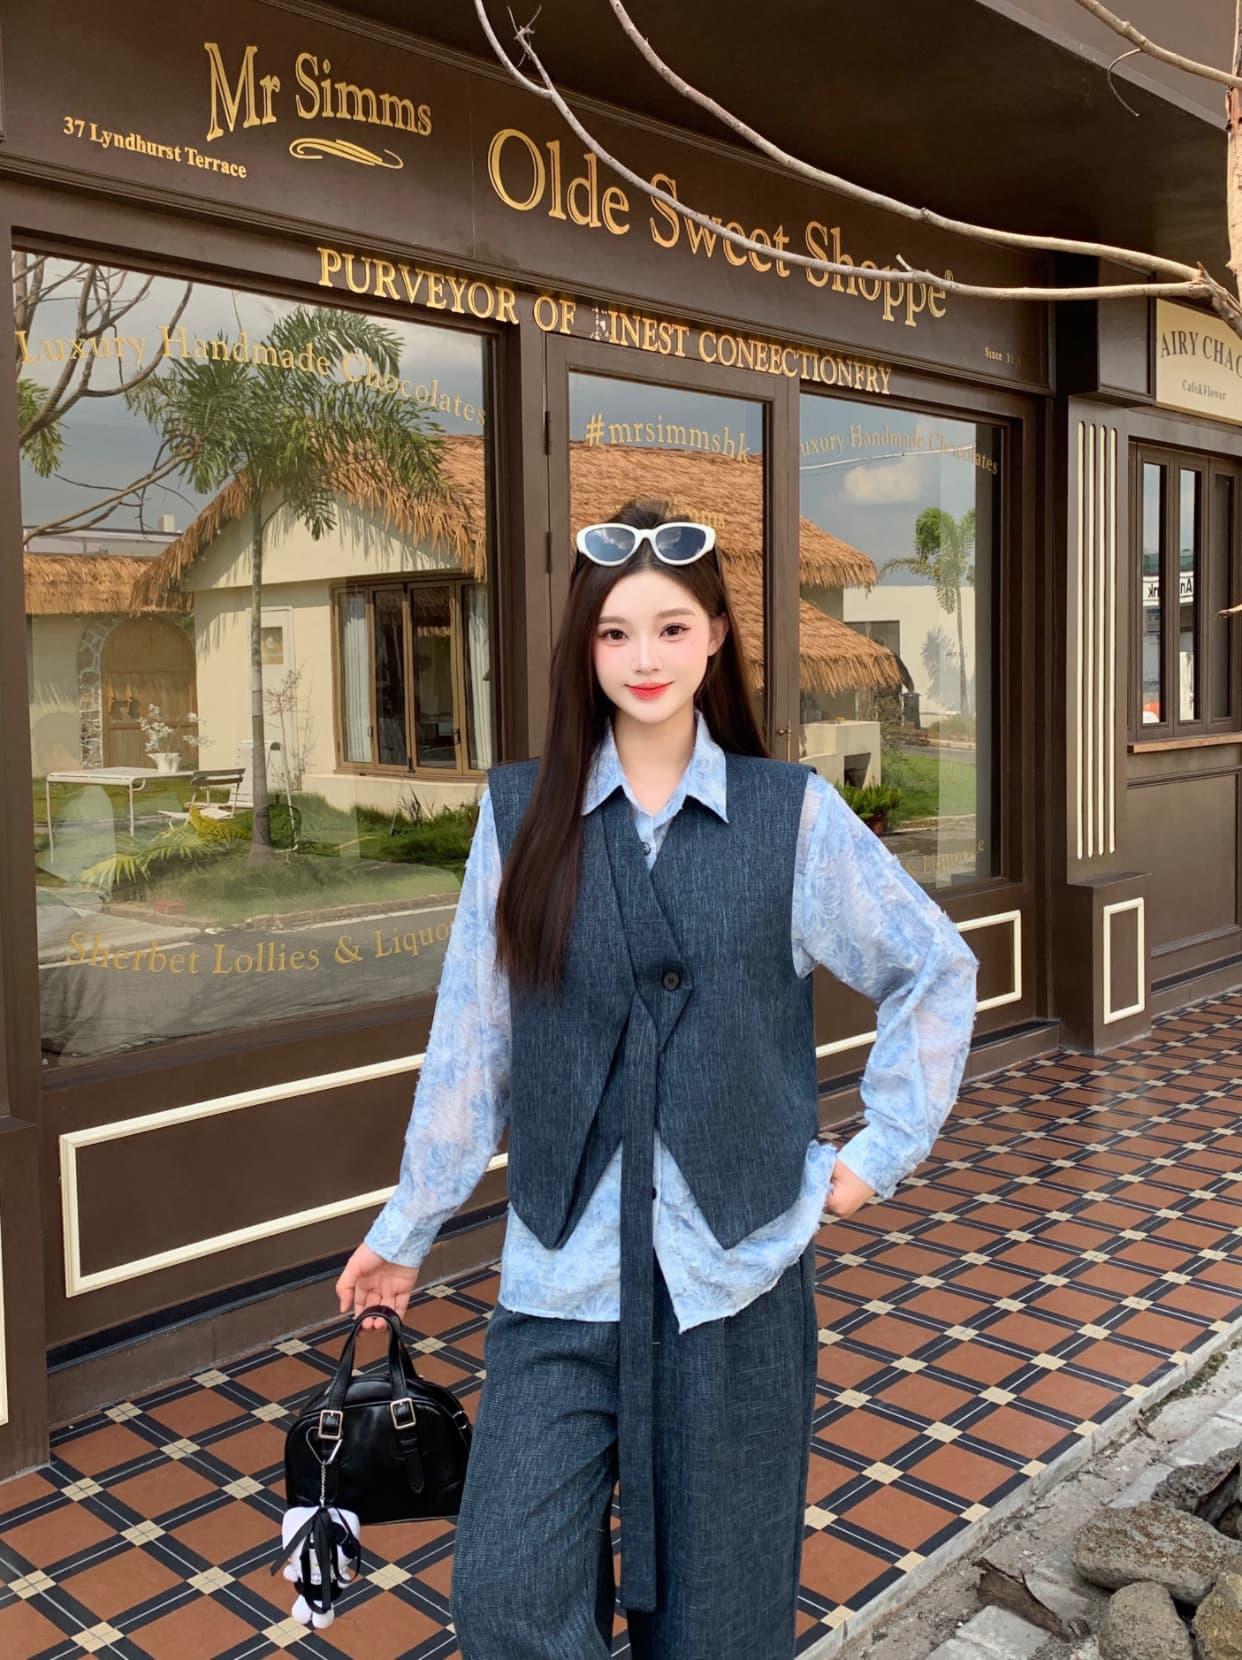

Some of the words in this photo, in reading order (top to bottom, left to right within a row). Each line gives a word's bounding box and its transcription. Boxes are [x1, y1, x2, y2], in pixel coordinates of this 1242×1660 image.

[204, 42, 281, 142] Mr
[295, 52, 433, 137] Simms
[63, 116, 85, 139] 37
[90, 122, 182, 163] Lyndhurst
[184, 148, 248, 179] Terrace
[487, 128, 631, 235] Olde
[650, 173, 791, 278] Sweet
[805, 220, 947, 327] Shoppe
[316, 247, 520, 325] PURVEYOR
[533, 295, 576, 334] OF
[15, 330, 146, 366] Luxury
[158, 325, 331, 376] Handmade
[341, 348, 487, 427] Chocolates
[1160, 330, 1199, 359] AIRY
[585, 413, 751, 465] #mrsimmshk
[800, 434, 843, 457] uxury
[65, 931, 200, 975] Sherbet
[212, 941, 321, 975] Lollies
[333, 934, 364, 965] &
[374, 920, 453, 958] Liquo
